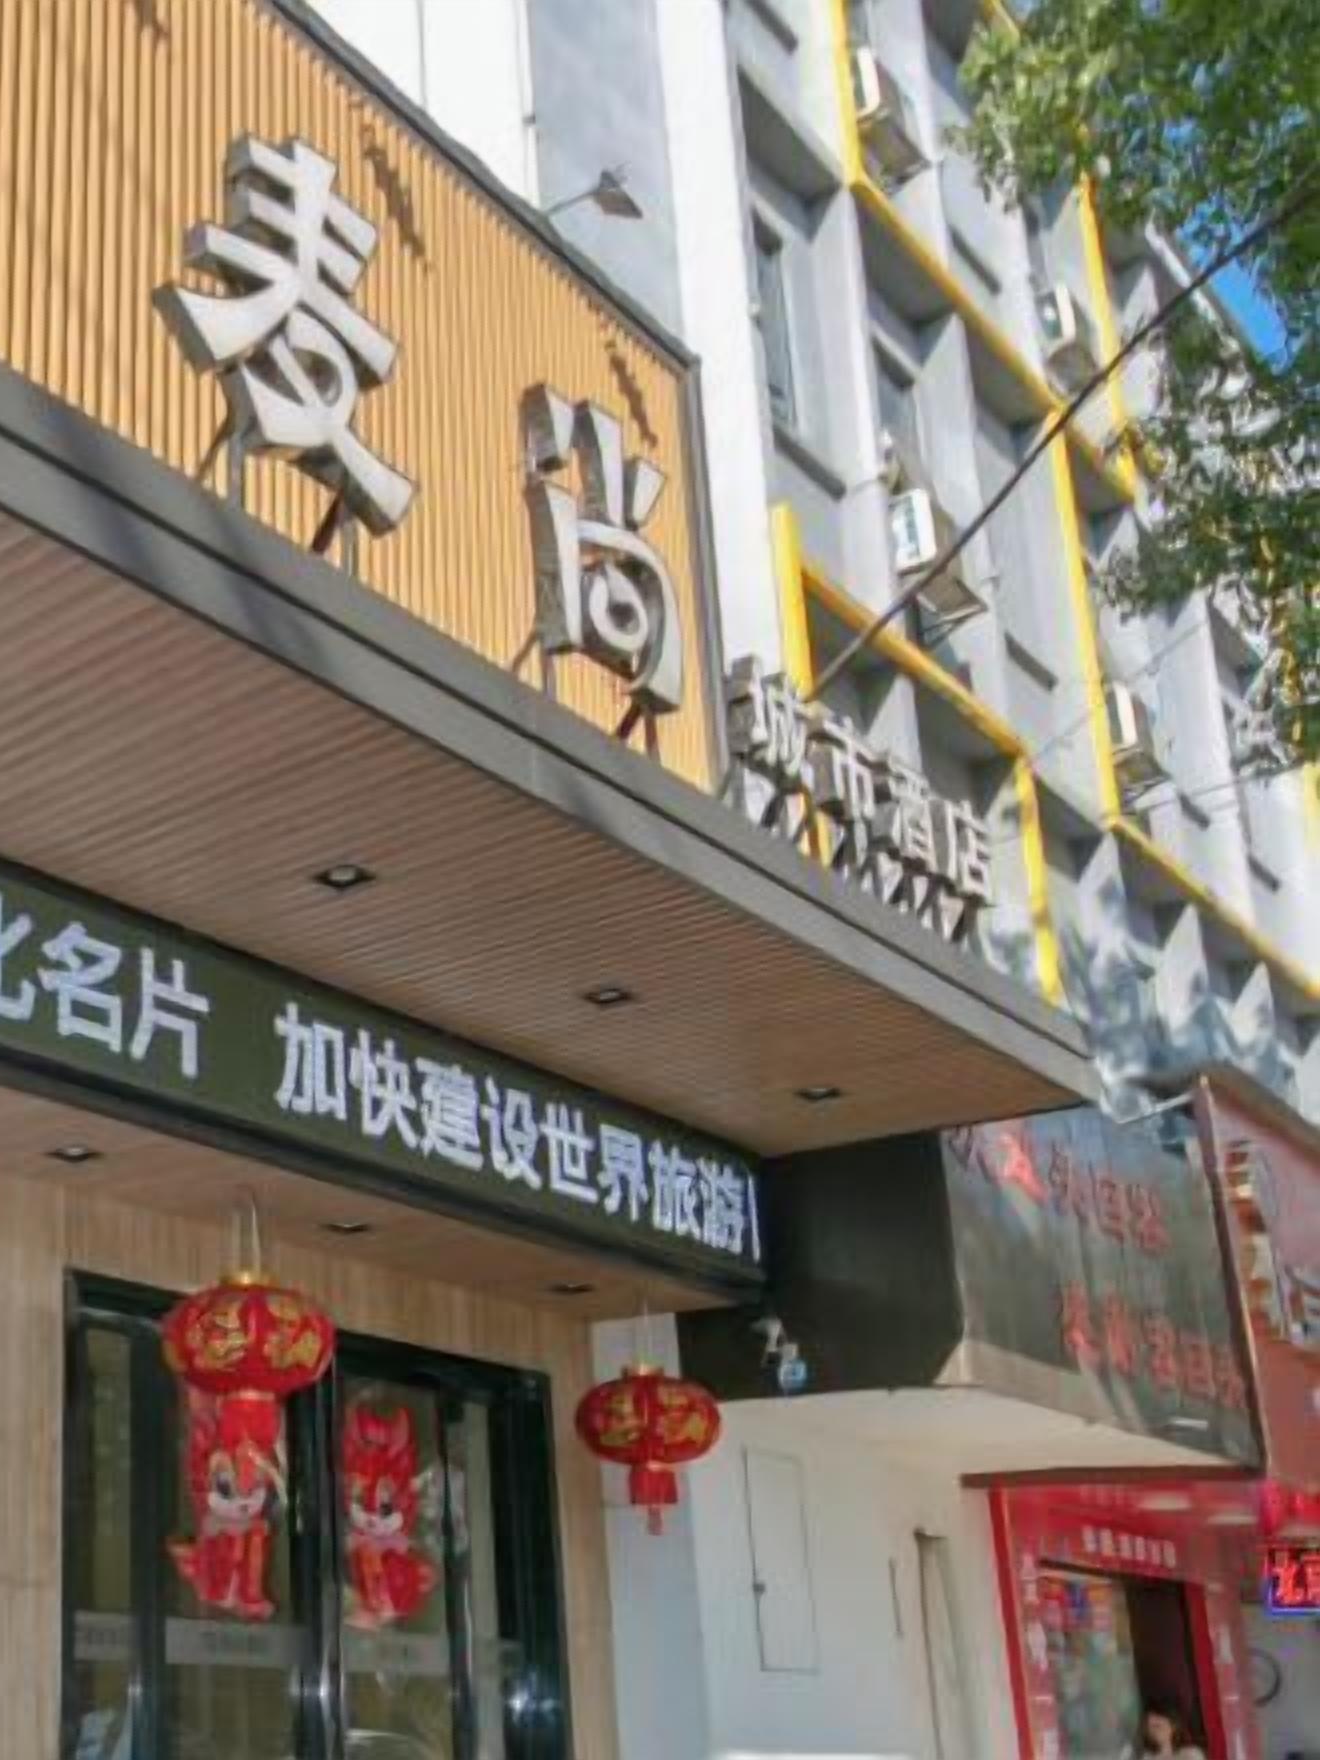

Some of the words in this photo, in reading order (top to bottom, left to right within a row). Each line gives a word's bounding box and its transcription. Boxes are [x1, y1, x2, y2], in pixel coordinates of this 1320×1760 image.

[730, 655, 989, 902] 城市酒店
[273, 1001, 760, 1263] 加快建设世界旅游
